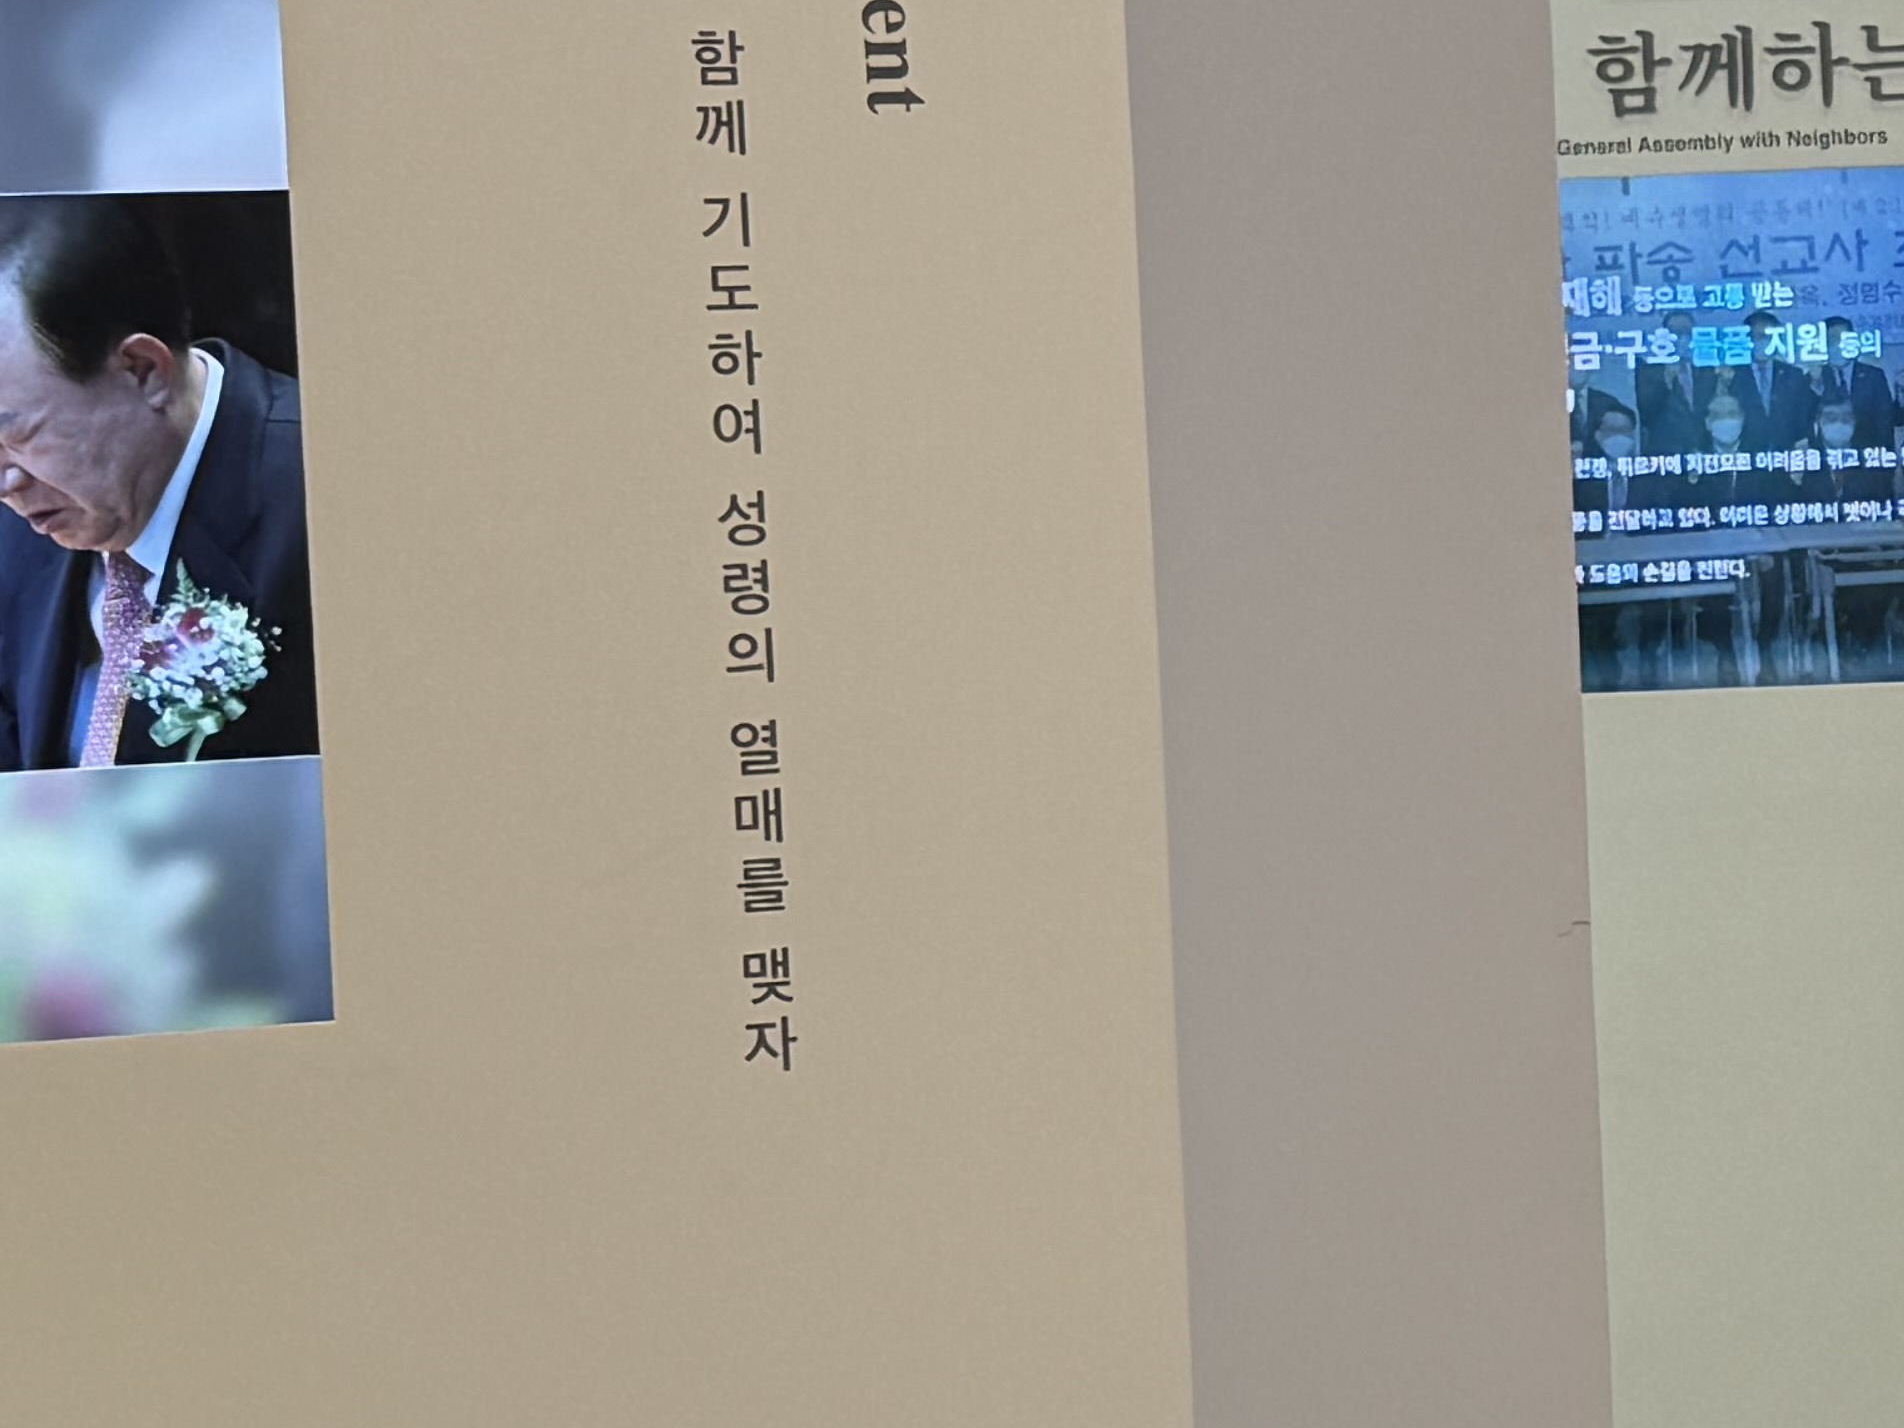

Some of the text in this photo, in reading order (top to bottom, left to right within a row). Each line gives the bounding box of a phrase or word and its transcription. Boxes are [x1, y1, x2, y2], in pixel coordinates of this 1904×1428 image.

[1557, 125, 1888, 156] General Assembly with Neighbors
[1593, 240, 1695, 286] 파송
[1717, 228, 1869, 279] 선교사
[1763, 320, 1830, 365] 지원
[690, 29, 799, 1073] 함께 기도하여 성령의 열매를 맺자
